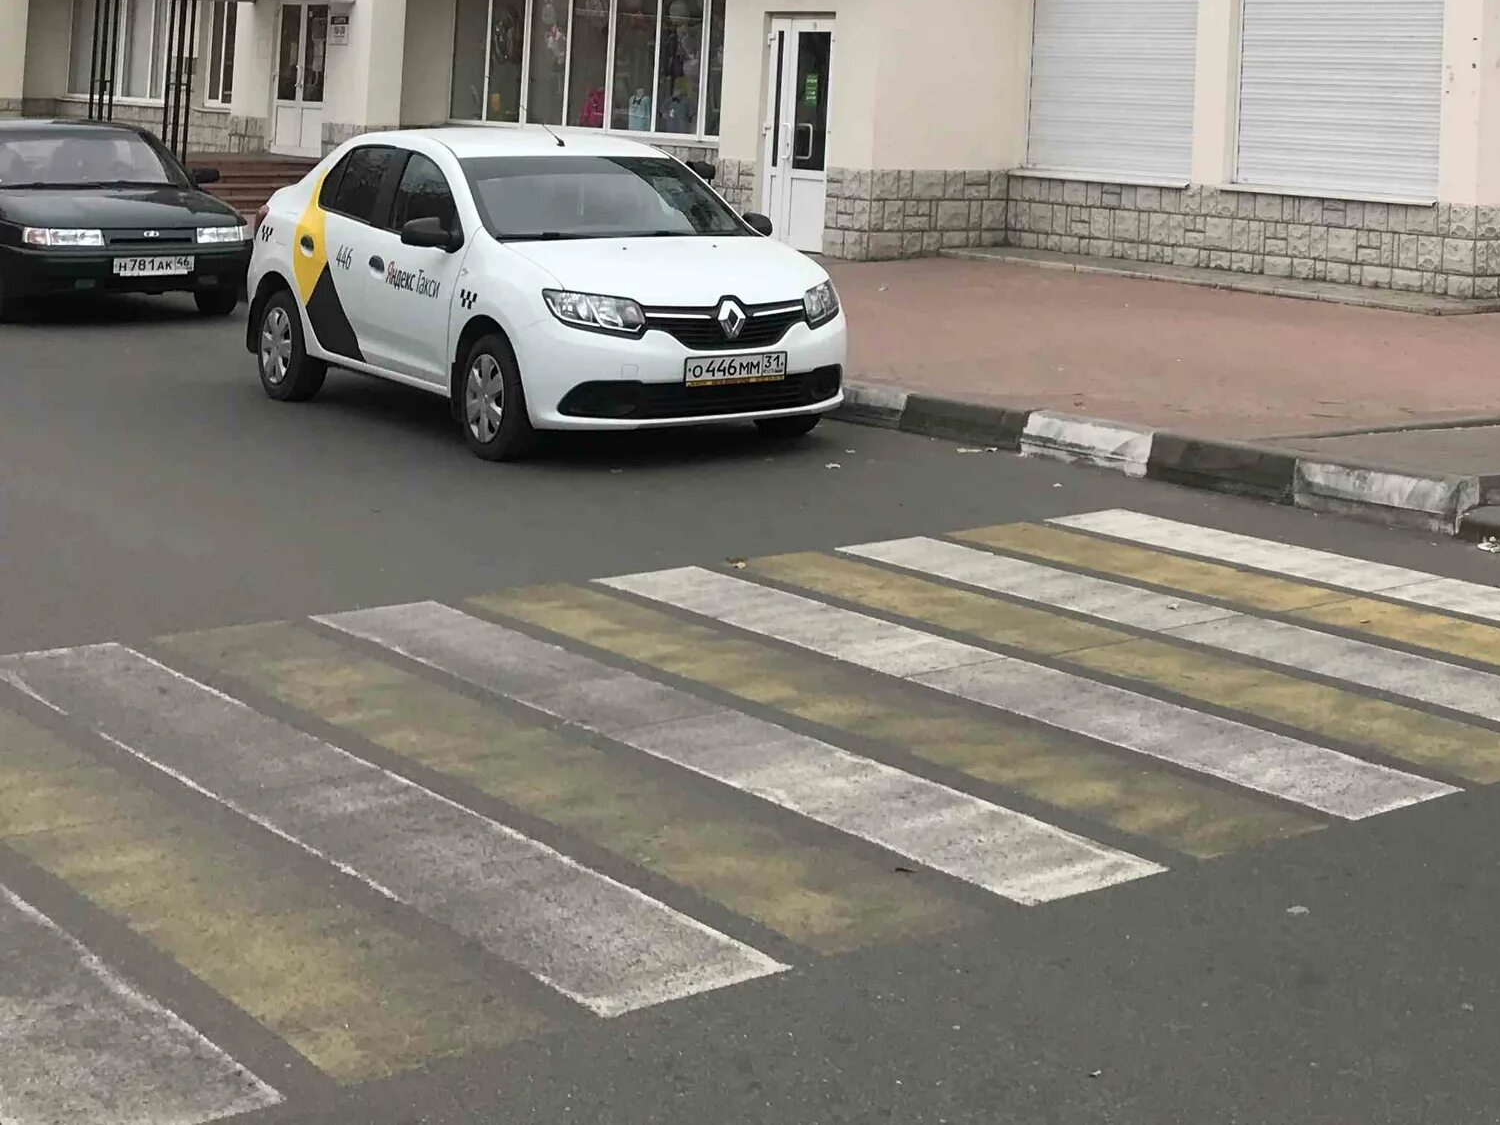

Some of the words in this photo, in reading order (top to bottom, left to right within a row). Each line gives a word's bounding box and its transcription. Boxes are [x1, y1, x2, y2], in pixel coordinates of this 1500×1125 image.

[336, 244, 353, 271] 446
[384, 260, 415, 290] Яндекс
[415, 268, 442, 300] Такси
